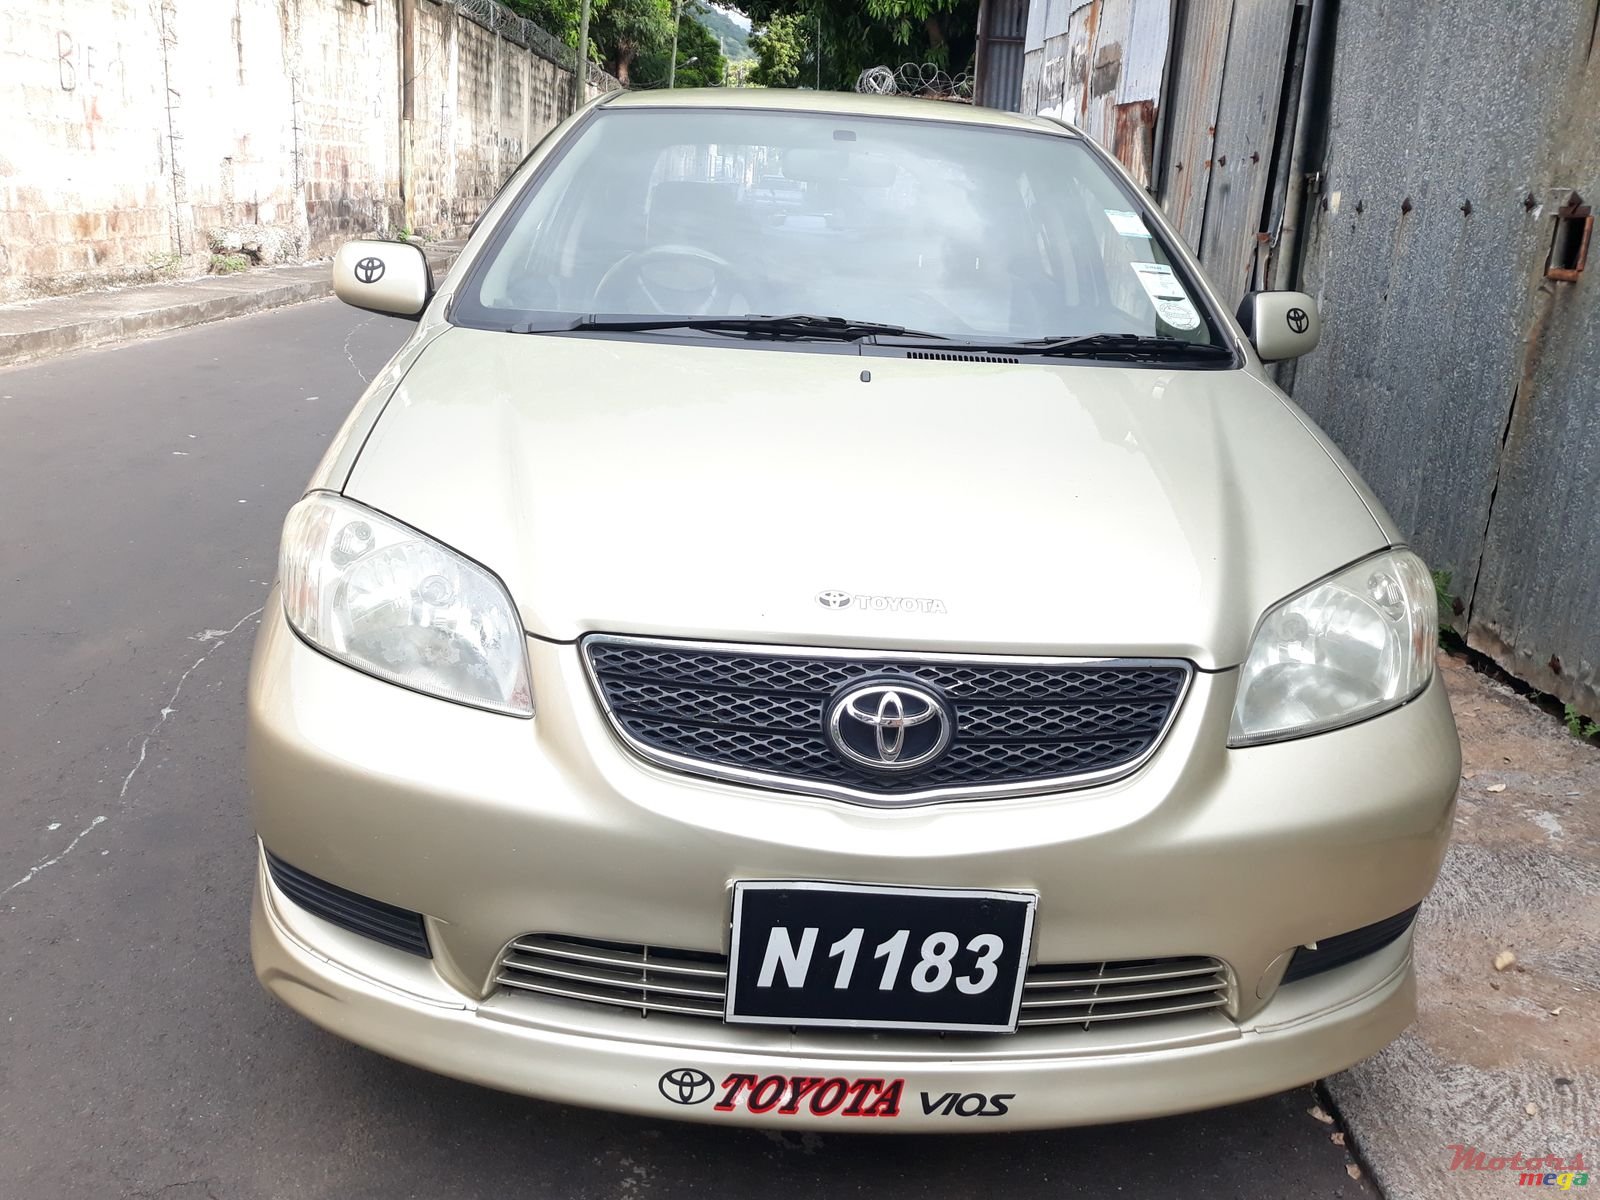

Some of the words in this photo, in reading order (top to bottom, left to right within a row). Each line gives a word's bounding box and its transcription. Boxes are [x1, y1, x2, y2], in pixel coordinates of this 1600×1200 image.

[854, 594, 948, 614] TOYOTA
[756, 926, 1004, 995] N1183
[713, 1073, 905, 1117] TOYOTA
[919, 1091, 1016, 1117] VIOS
